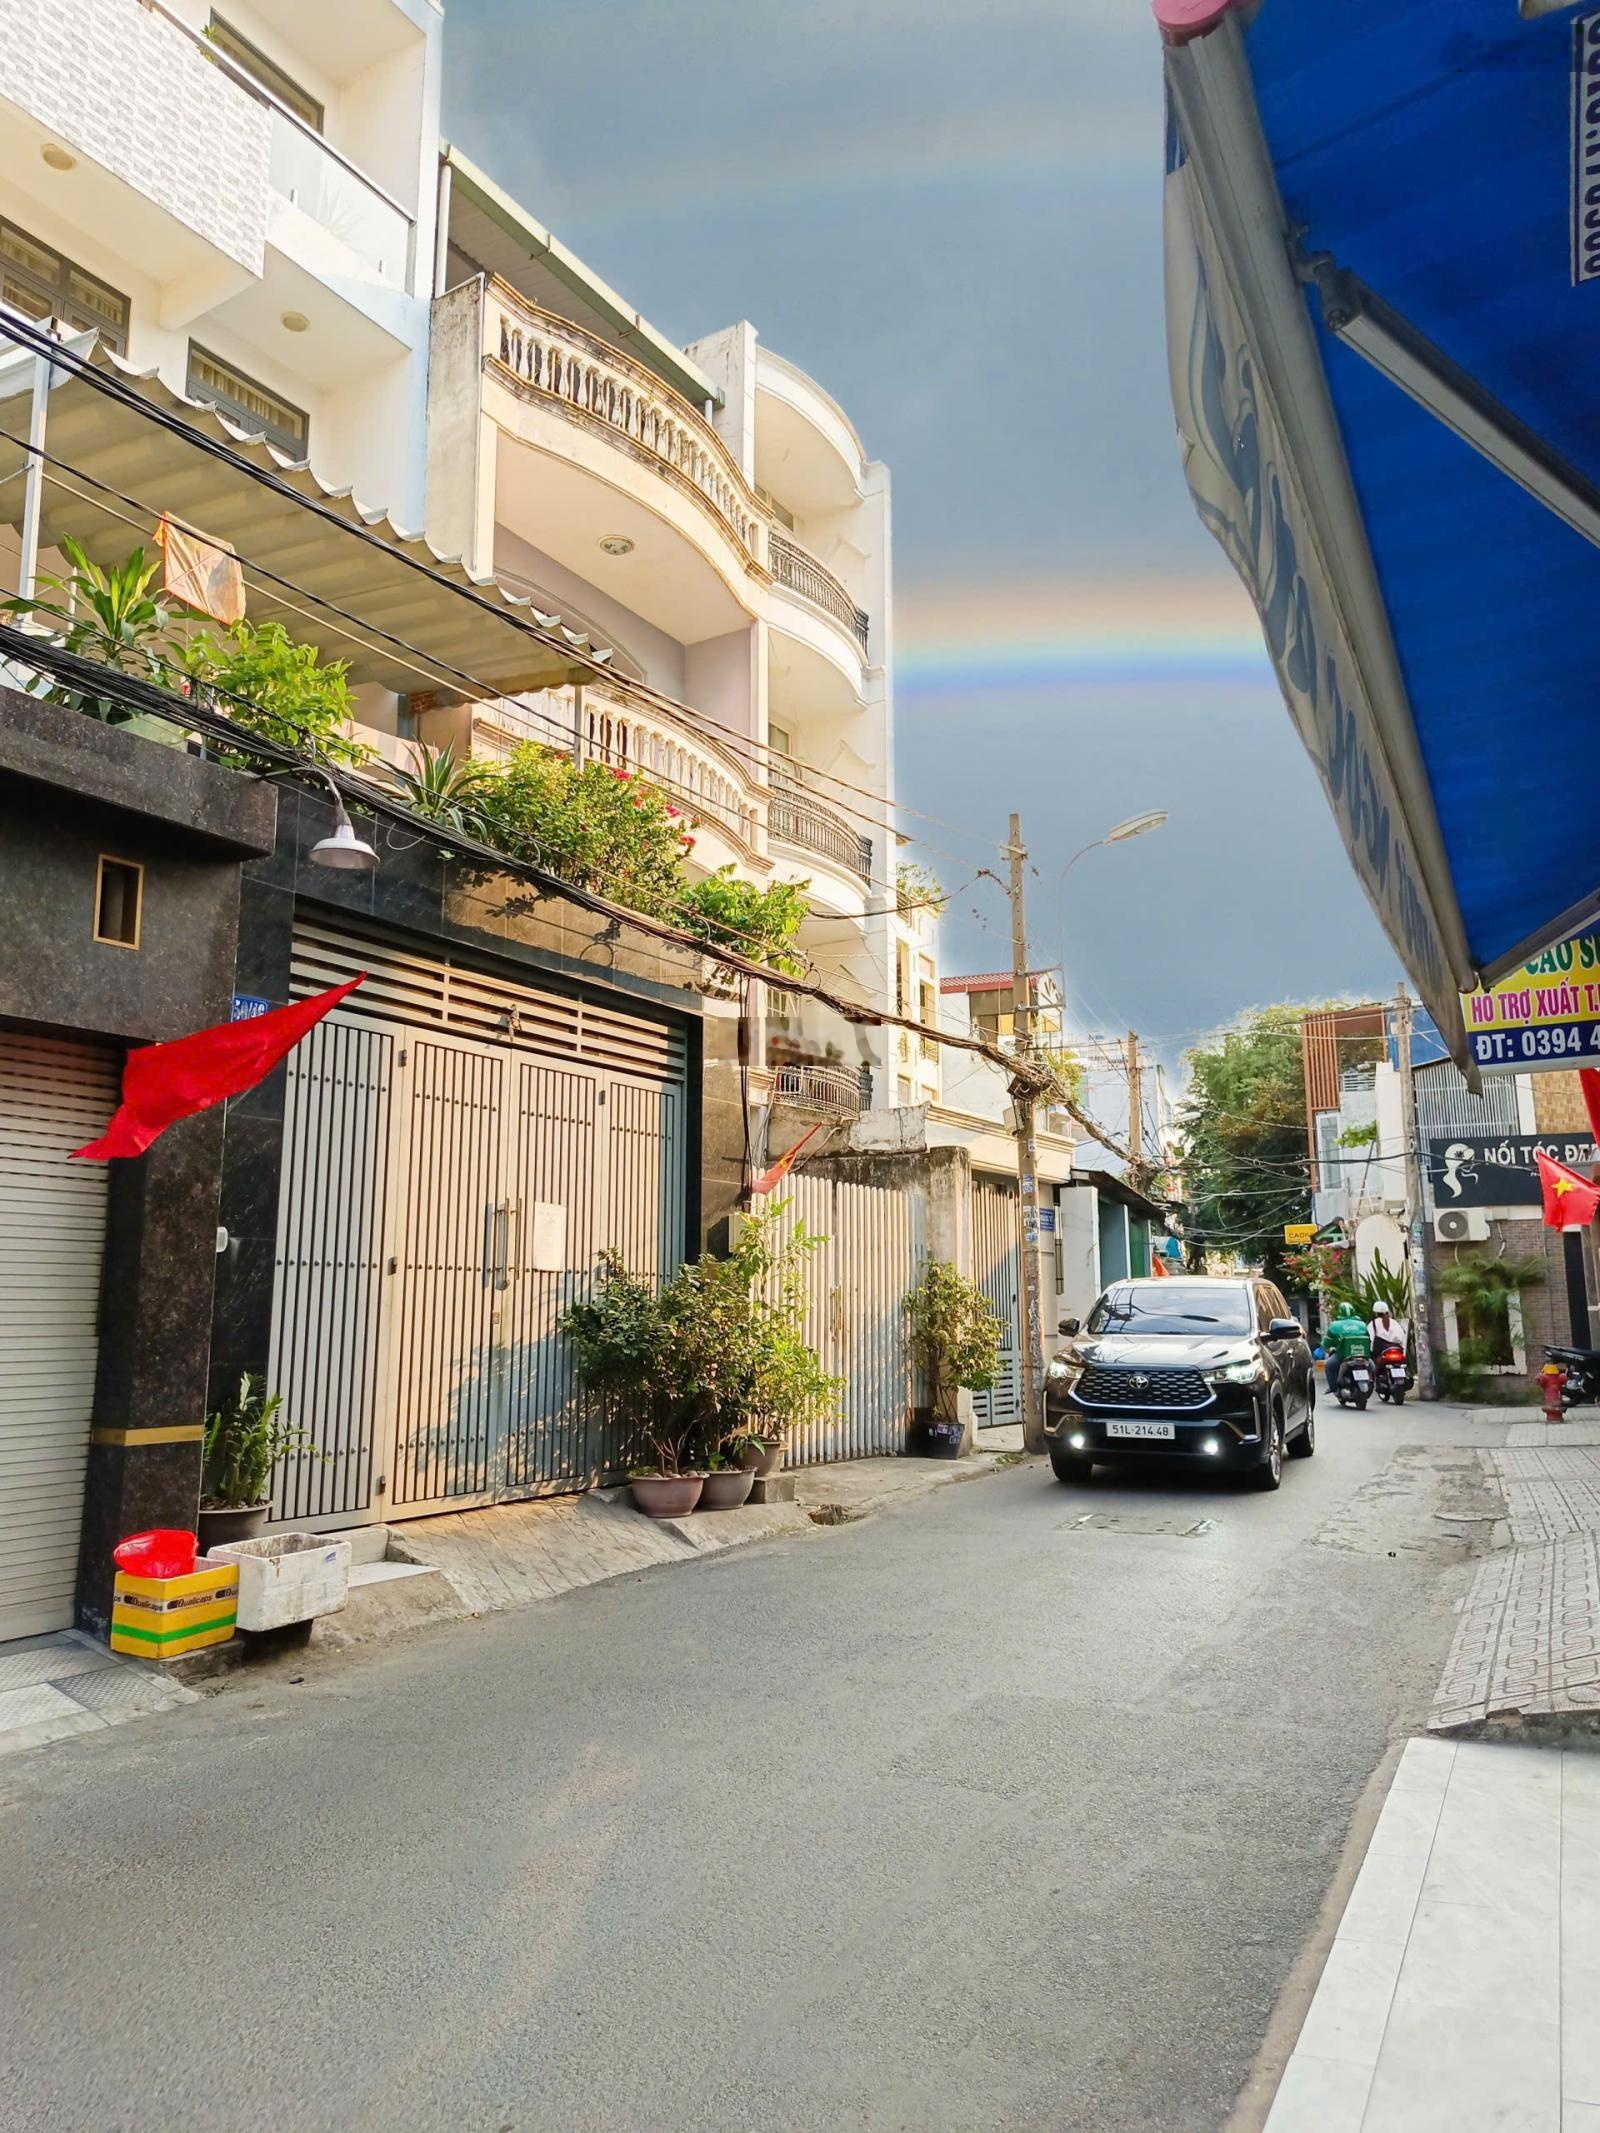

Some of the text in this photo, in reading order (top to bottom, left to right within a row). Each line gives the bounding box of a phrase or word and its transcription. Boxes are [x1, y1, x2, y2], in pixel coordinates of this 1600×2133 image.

[1498, 989, 1531, 1024] TRỢ
[1536, 977, 1579, 1017] XUẤT
[1476, 1033, 1513, 1060] ĐT:
[1521, 1026, 1582, 1056] 0394
